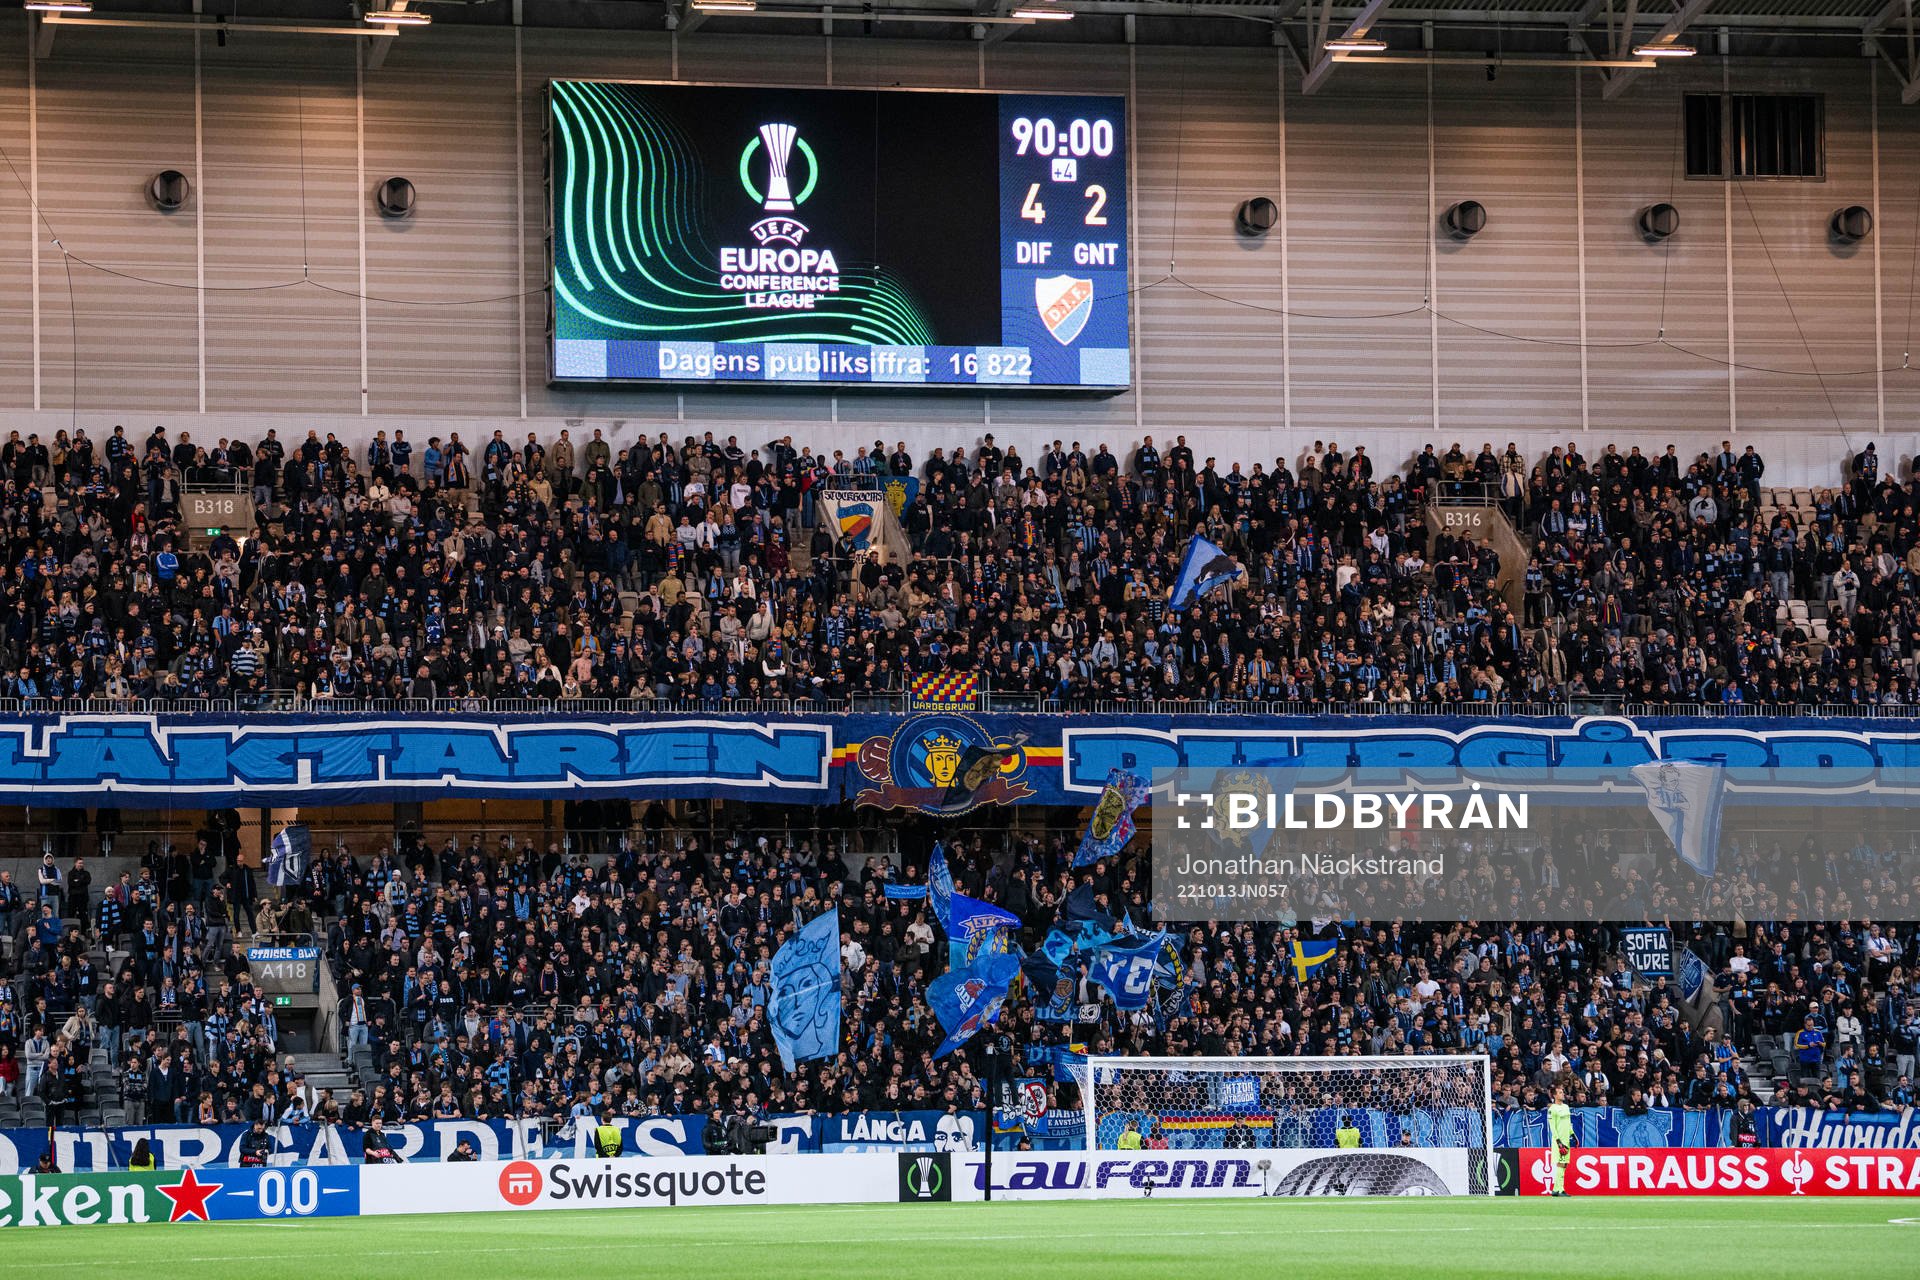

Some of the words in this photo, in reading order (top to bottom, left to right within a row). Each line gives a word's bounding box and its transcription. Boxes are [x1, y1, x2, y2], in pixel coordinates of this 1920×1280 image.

[1012, 118, 1113, 156] 90:00
[1054, 163, 1073, 179] +4
[1021, 183, 1046, 224] 4
[1084, 184, 1107, 225] 2
[753, 221, 805, 243] UEFA
[720, 247, 839, 273] EUROPA
[1016, 241, 1052, 264] DIF
[1074, 242, 1118, 265] GNT
[720, 274, 840, 291] CONFERENCE
[658, 348, 760, 376] Dagens
[770, 351, 930, 377] publiksiffra:
[950, 353, 978, 374] 16
[987, 354, 1032, 375] 822
[194, 500, 233, 514] B318
[1446, 512, 1480, 526] B316
[260, 963, 306, 979] A118
[841, 1114, 926, 1142] LÅNGA
[549, 1163, 766, 1206] Swissquote
[1575, 1154, 1770, 1190] STRAUSS
[258, 1169, 319, 1216] 0.0
